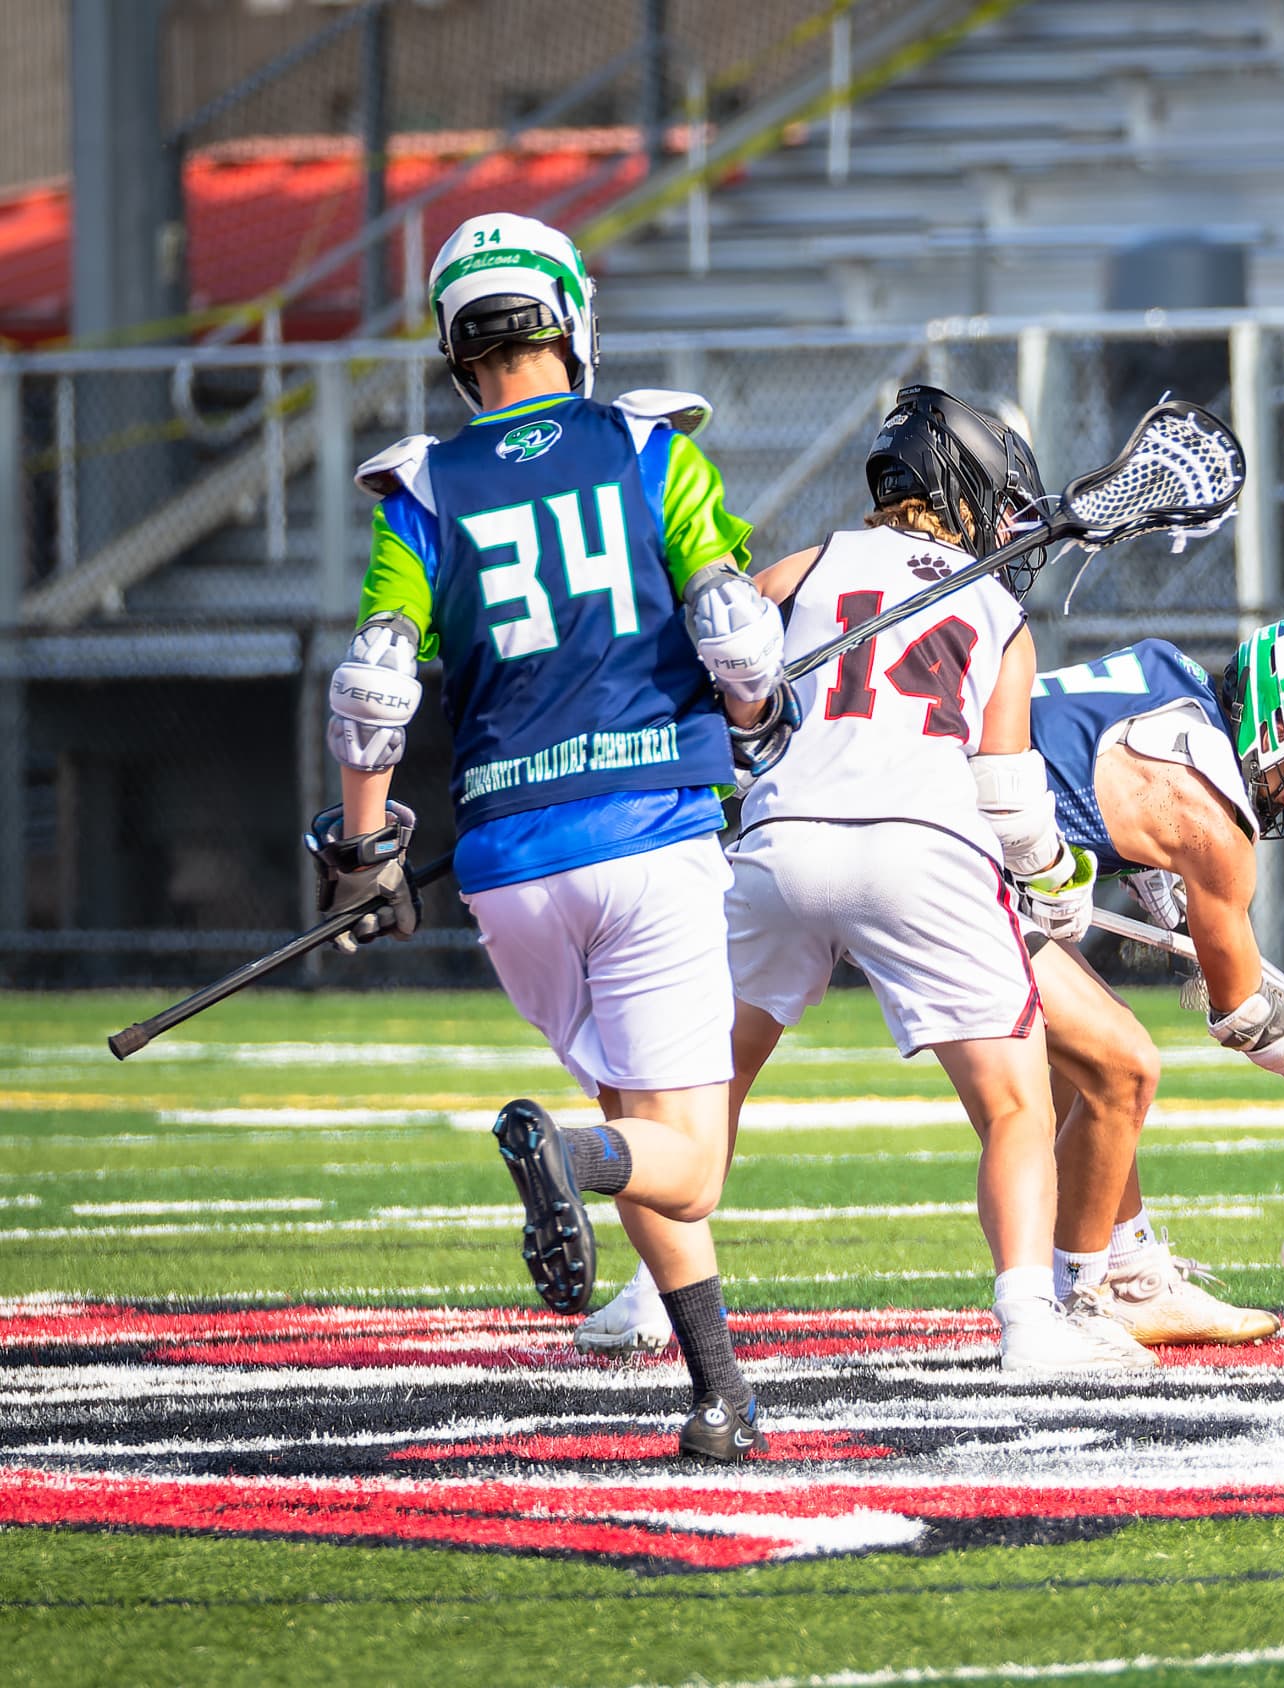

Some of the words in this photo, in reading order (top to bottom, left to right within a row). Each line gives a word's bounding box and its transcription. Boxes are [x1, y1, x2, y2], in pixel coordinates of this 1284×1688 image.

[473, 228, 501, 248] 34
[459, 251, 521, 275] Falcons
[456, 481, 641, 662] 34
[824, 590, 979, 745] 14
[333, 680, 411, 710] AVERIK
